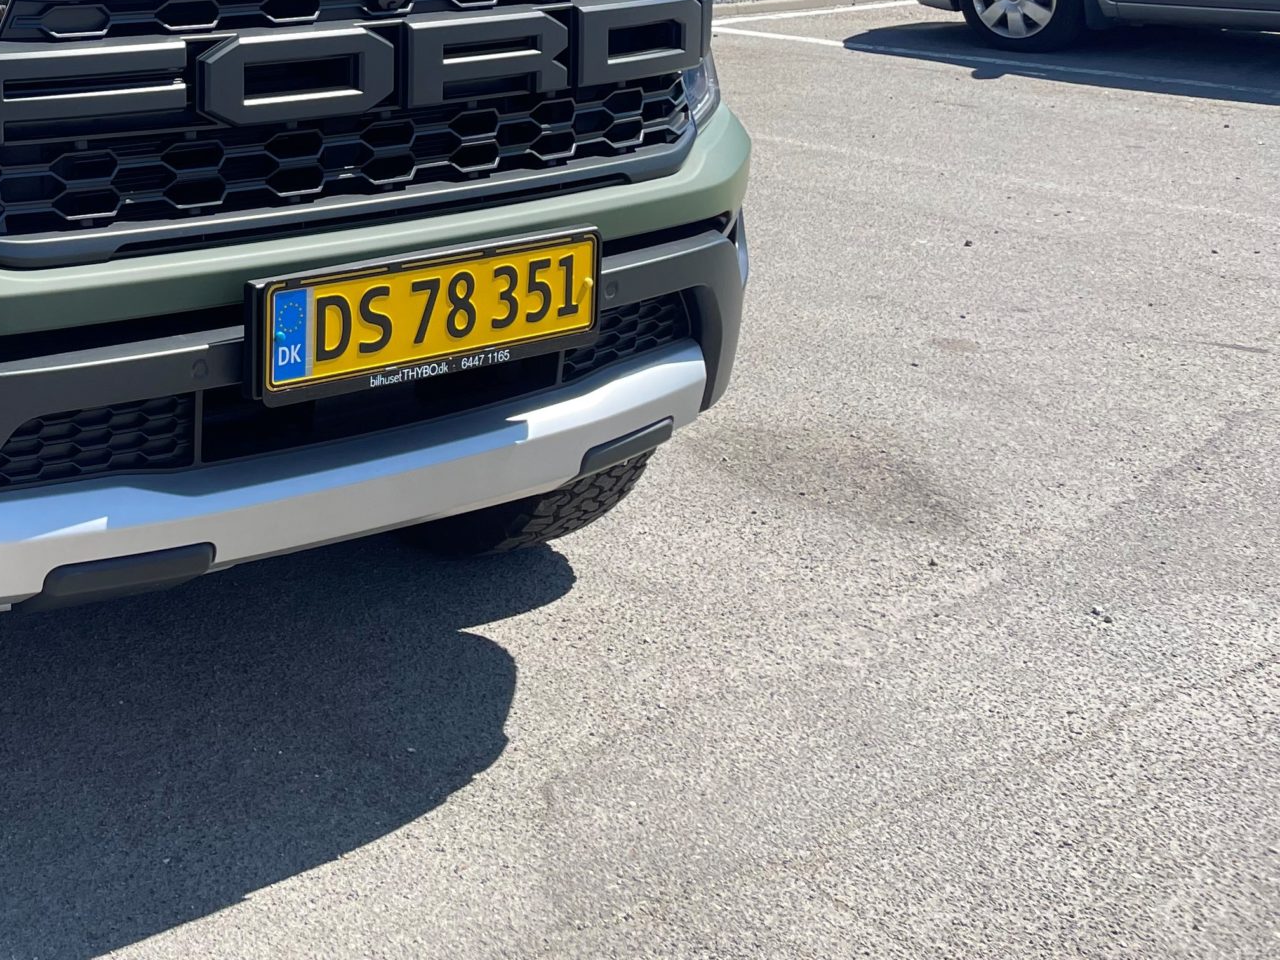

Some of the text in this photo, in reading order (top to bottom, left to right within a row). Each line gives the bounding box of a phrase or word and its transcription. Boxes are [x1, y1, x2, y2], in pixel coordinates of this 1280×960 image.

[316, 252, 580, 362] DS 78 351
[277, 343, 302, 366] DK
[461, 355, 485, 370] 6447
[488, 349, 510, 365] 1165
